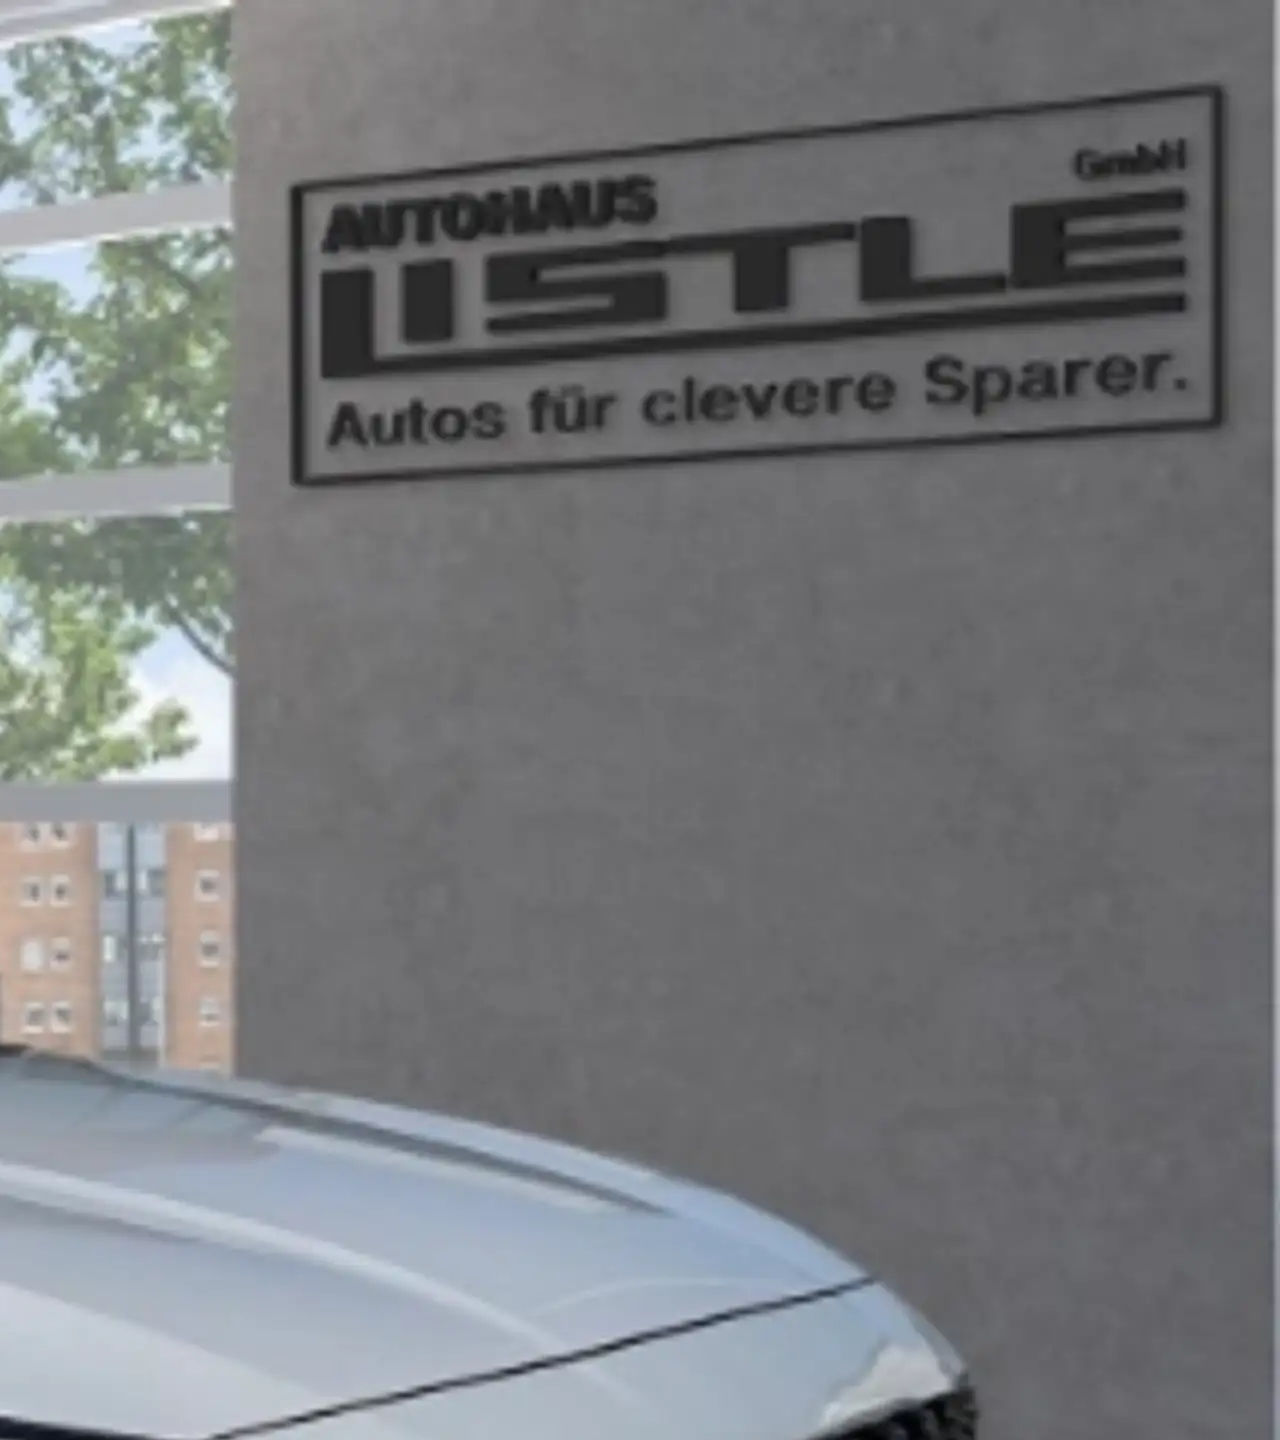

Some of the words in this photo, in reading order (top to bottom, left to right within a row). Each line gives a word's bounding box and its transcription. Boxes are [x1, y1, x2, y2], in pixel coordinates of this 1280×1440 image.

[1072, 137, 1188, 182] GmbH
[320, 174, 659, 254] AUTOHAUS
[320, 187, 1189, 380] LISTLE
[326, 398, 507, 448] Autos
[528, 383, 617, 435] für
[640, 371, 899, 428] clevere
[923, 351, 1188, 415] Sparer.
